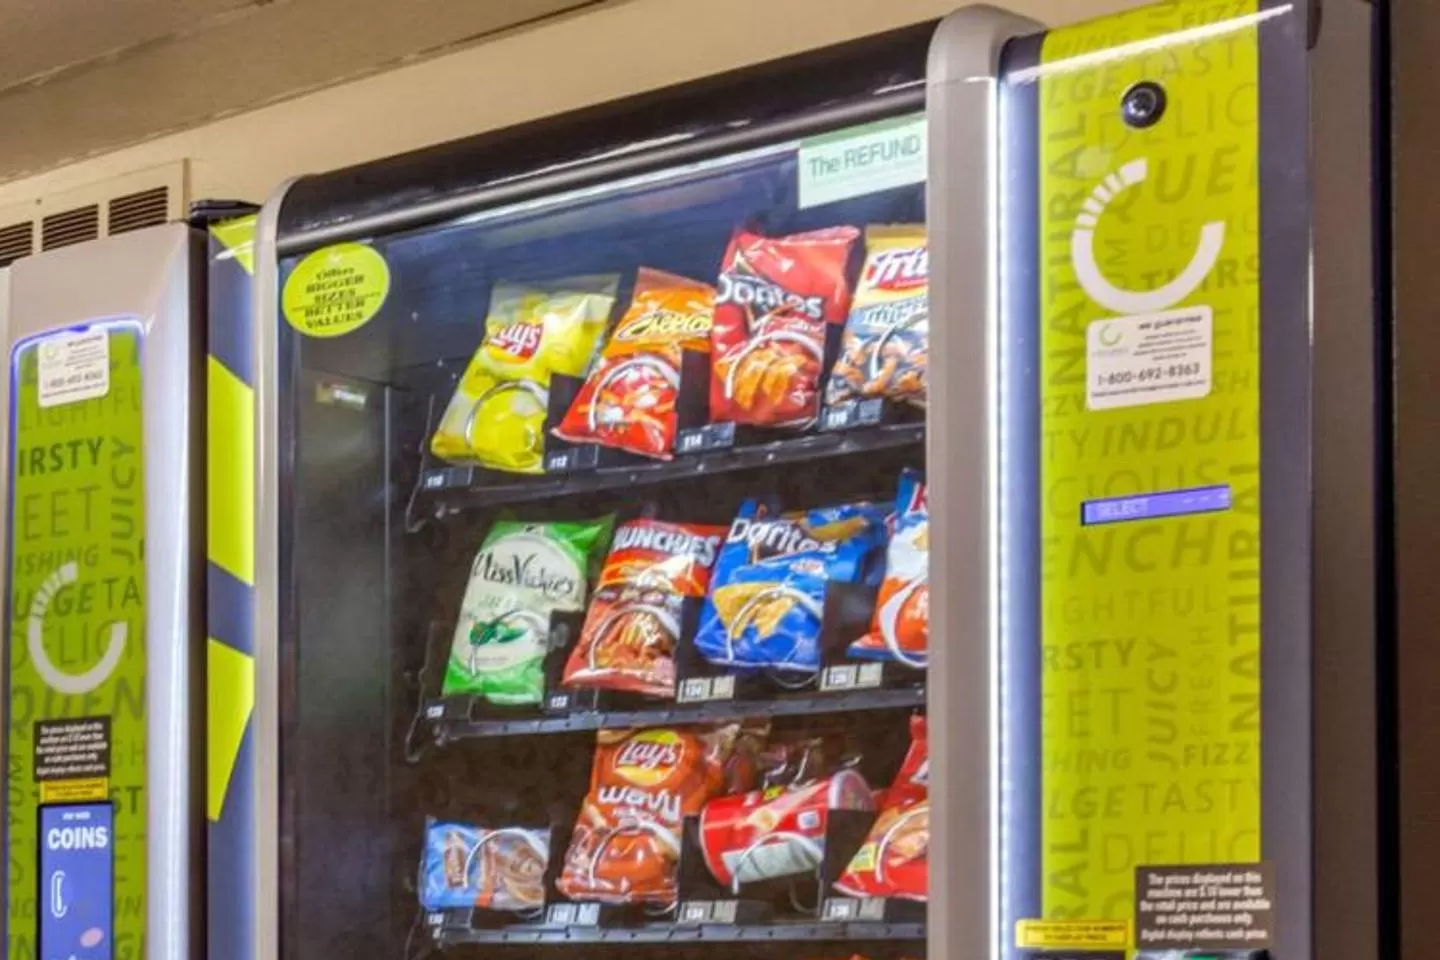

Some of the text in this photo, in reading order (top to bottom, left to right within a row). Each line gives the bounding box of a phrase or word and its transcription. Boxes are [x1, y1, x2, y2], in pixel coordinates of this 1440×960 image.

[808, 134, 922, 177] The REFUND
[306, 275, 365, 293] BIGGER
[18, 435, 105, 477] IRSTY
[110, 435, 137, 567] JUICY
[1144, 636, 1179, 772] JUICY
[47, 825, 109, 849] COINS
